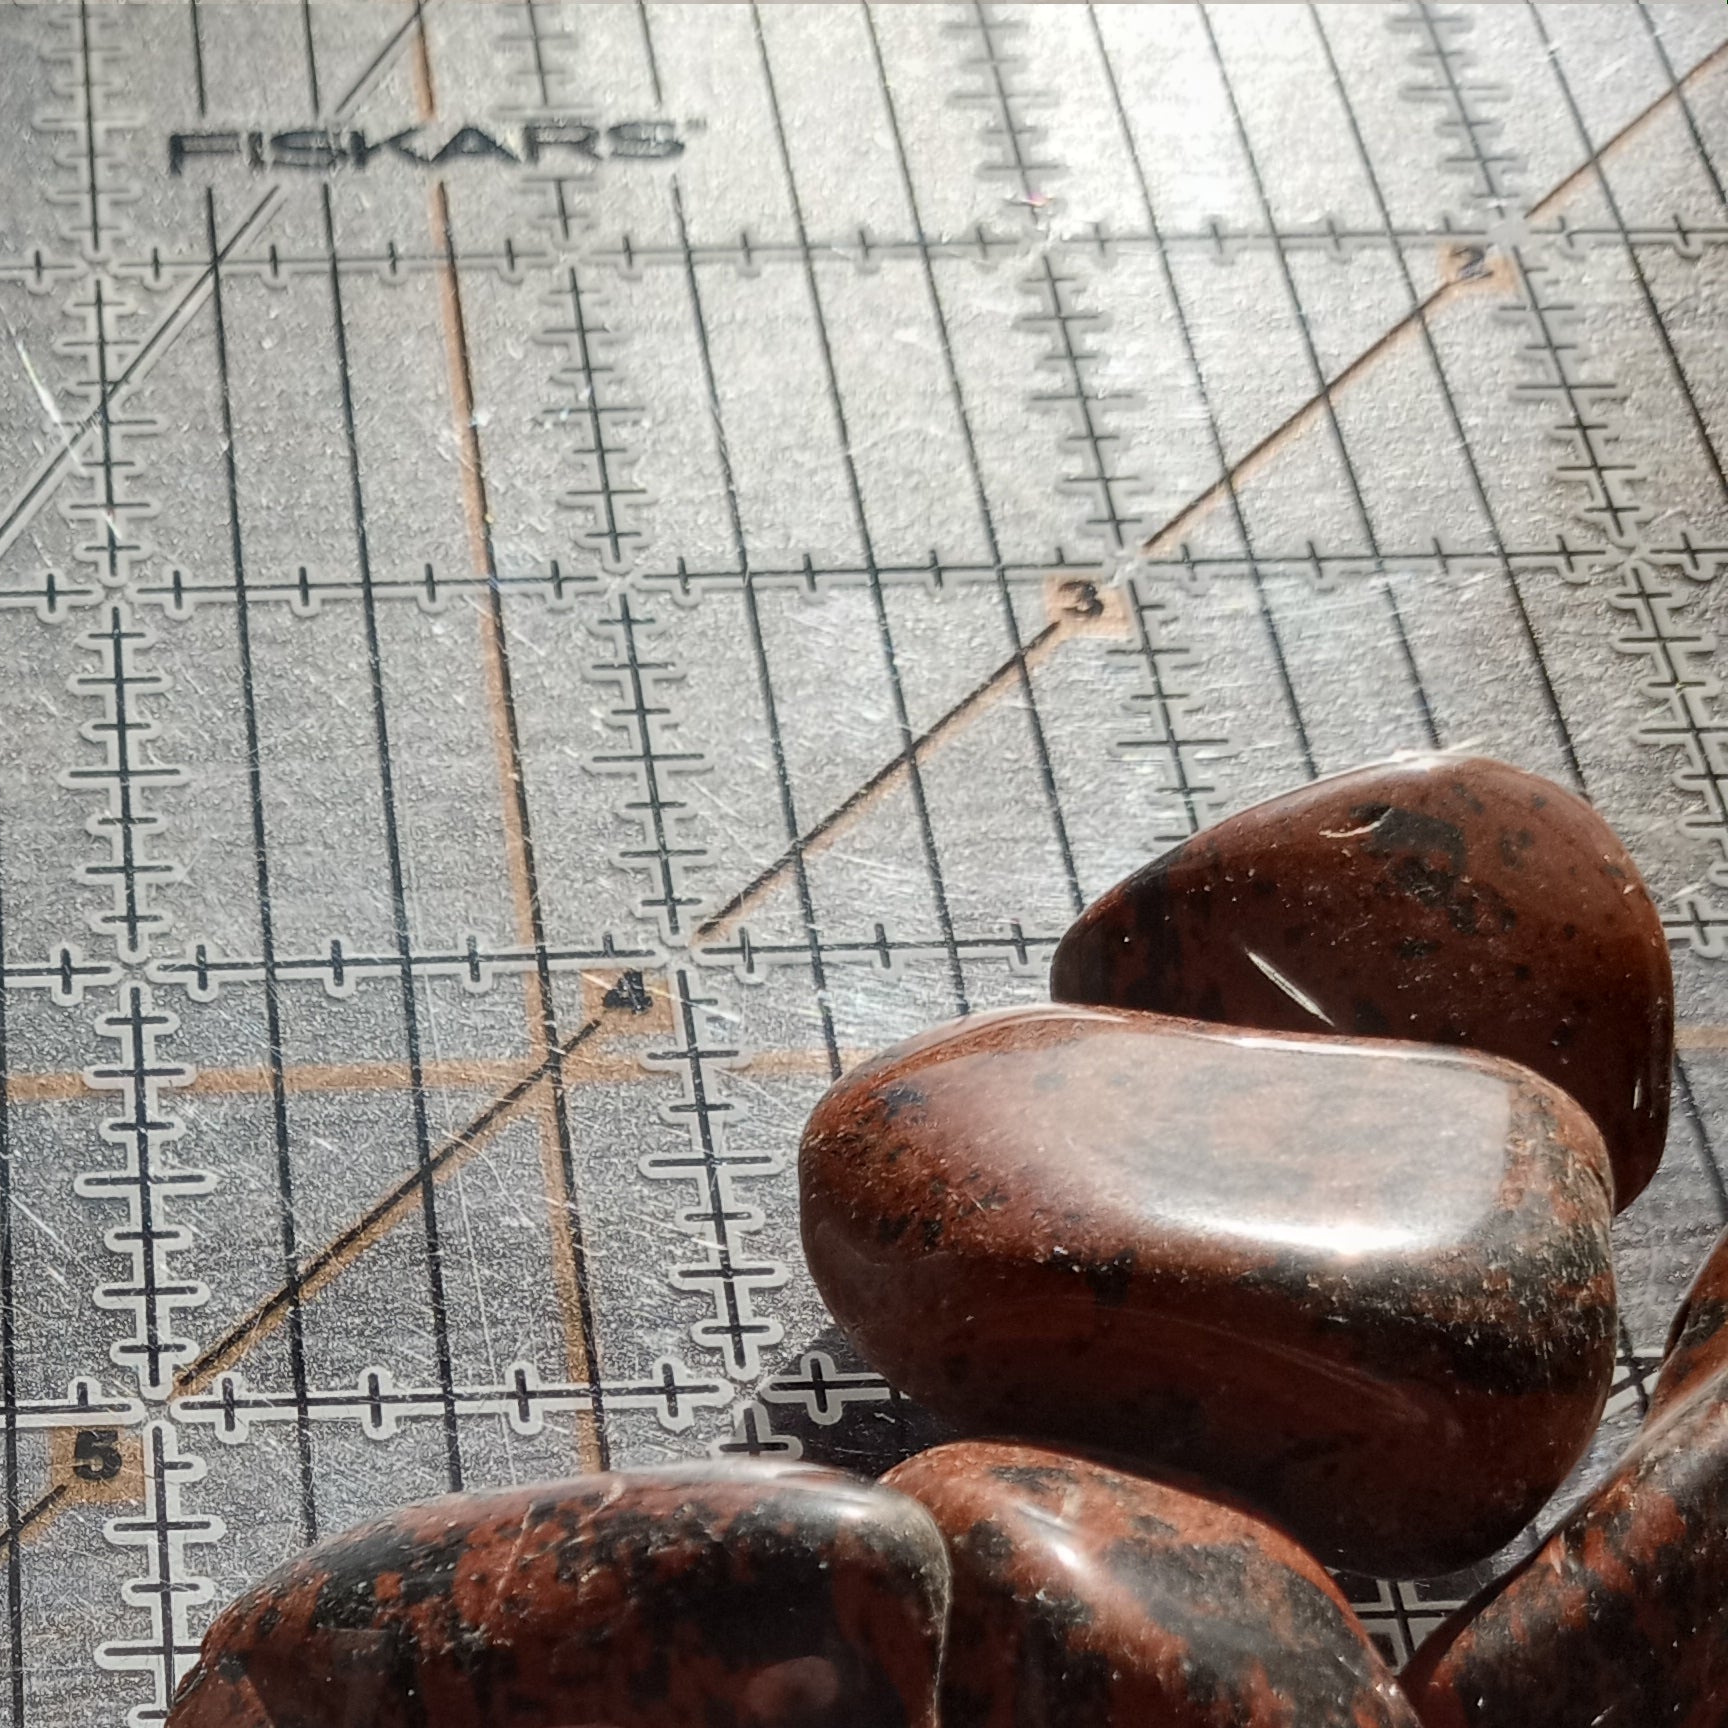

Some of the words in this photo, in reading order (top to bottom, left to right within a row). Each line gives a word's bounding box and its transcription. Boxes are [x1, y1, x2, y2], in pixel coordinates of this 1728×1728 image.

[168, 118, 686, 177] FISKARS
[1058, 580, 1104, 618] 3
[601, 967, 653, 1015] 4
[73, 1431, 122, 1479] 5
